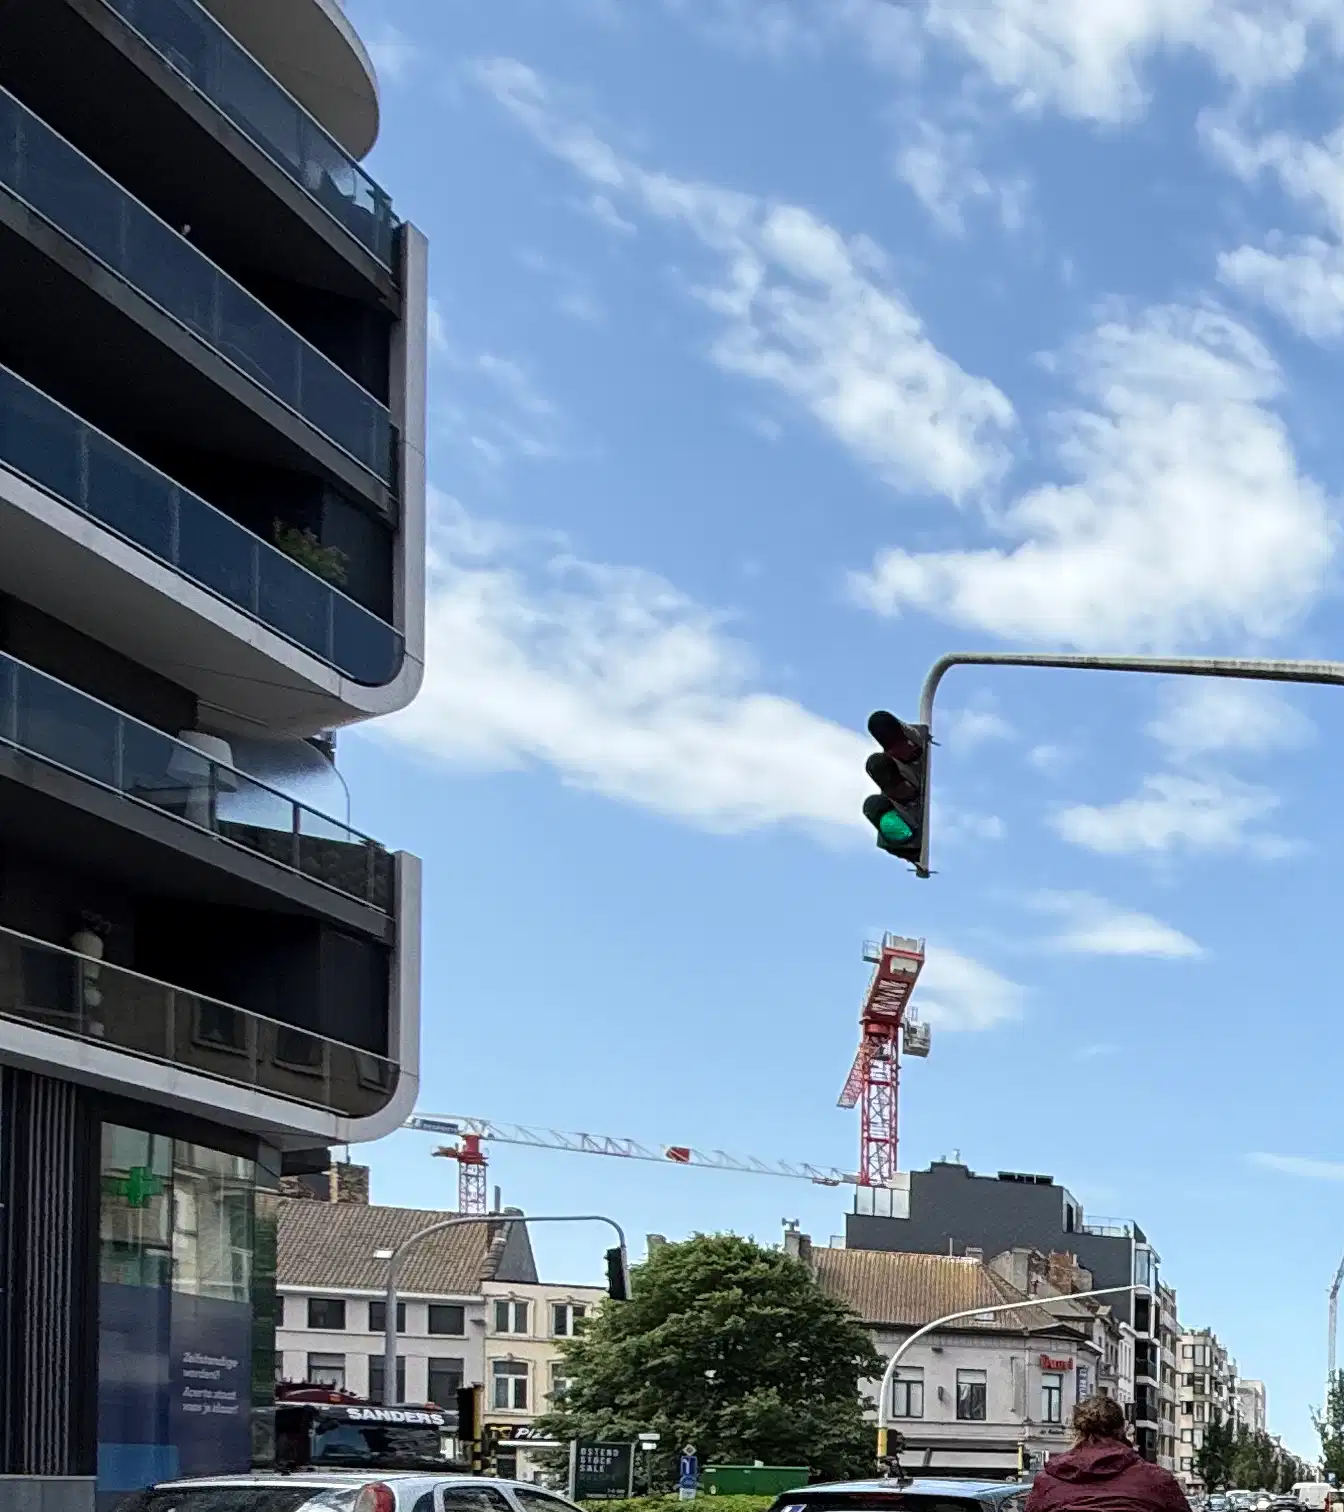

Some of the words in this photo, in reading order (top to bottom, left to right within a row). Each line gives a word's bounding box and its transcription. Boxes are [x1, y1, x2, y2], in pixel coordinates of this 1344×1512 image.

[346, 1407, 445, 1426] SANDERS
[580, 1447, 620, 1457] OSTEND
[580, 1456, 612, 1465] STOCK
[580, 1464, 605, 1473] SALE
